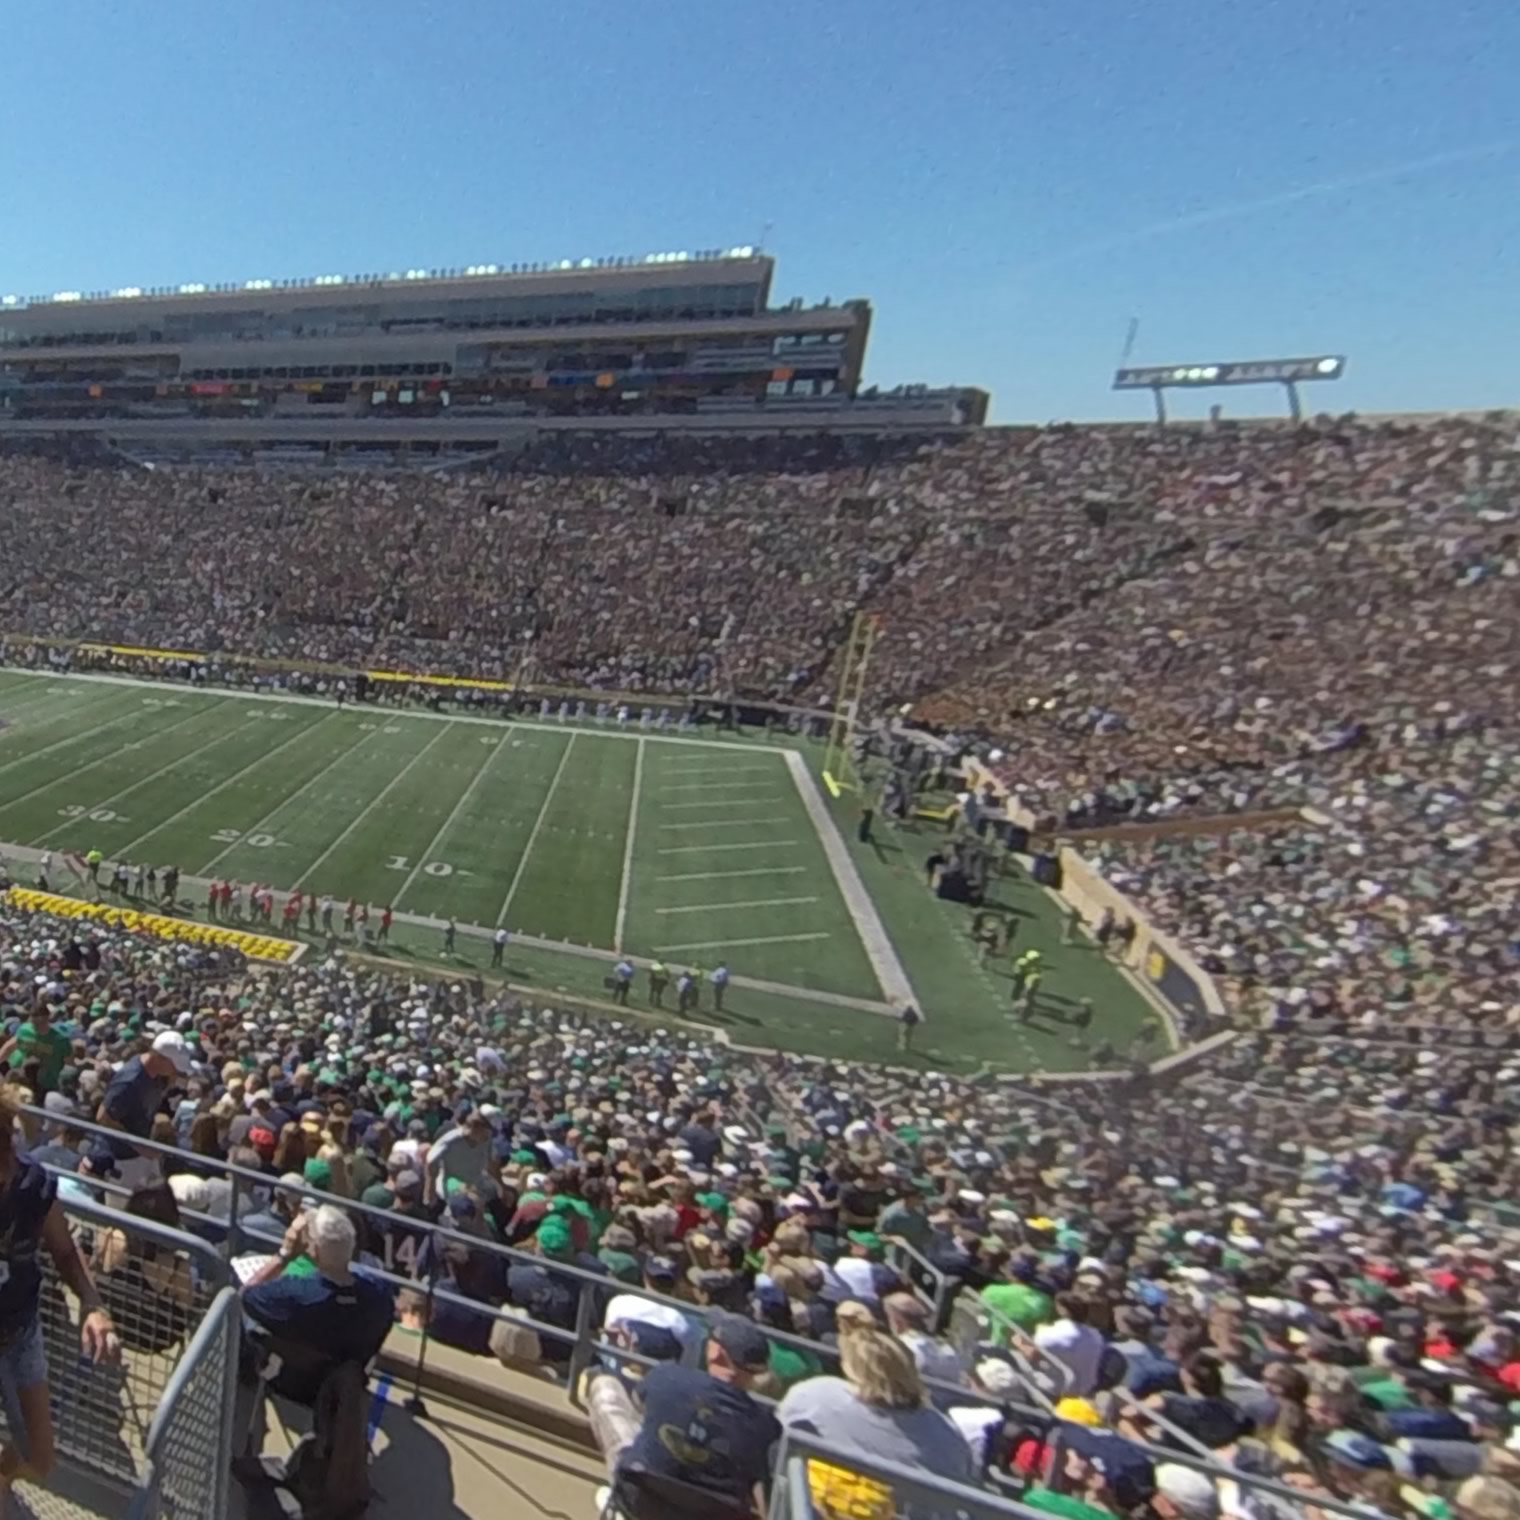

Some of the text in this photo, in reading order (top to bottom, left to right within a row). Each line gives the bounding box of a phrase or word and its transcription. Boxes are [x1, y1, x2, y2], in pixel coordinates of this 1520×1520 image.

[57, 804, 117, 822] 30
[209, 828, 266, 848] 20
[385, 855, 453, 877] 10
[384, 1232, 418, 1281] 14
